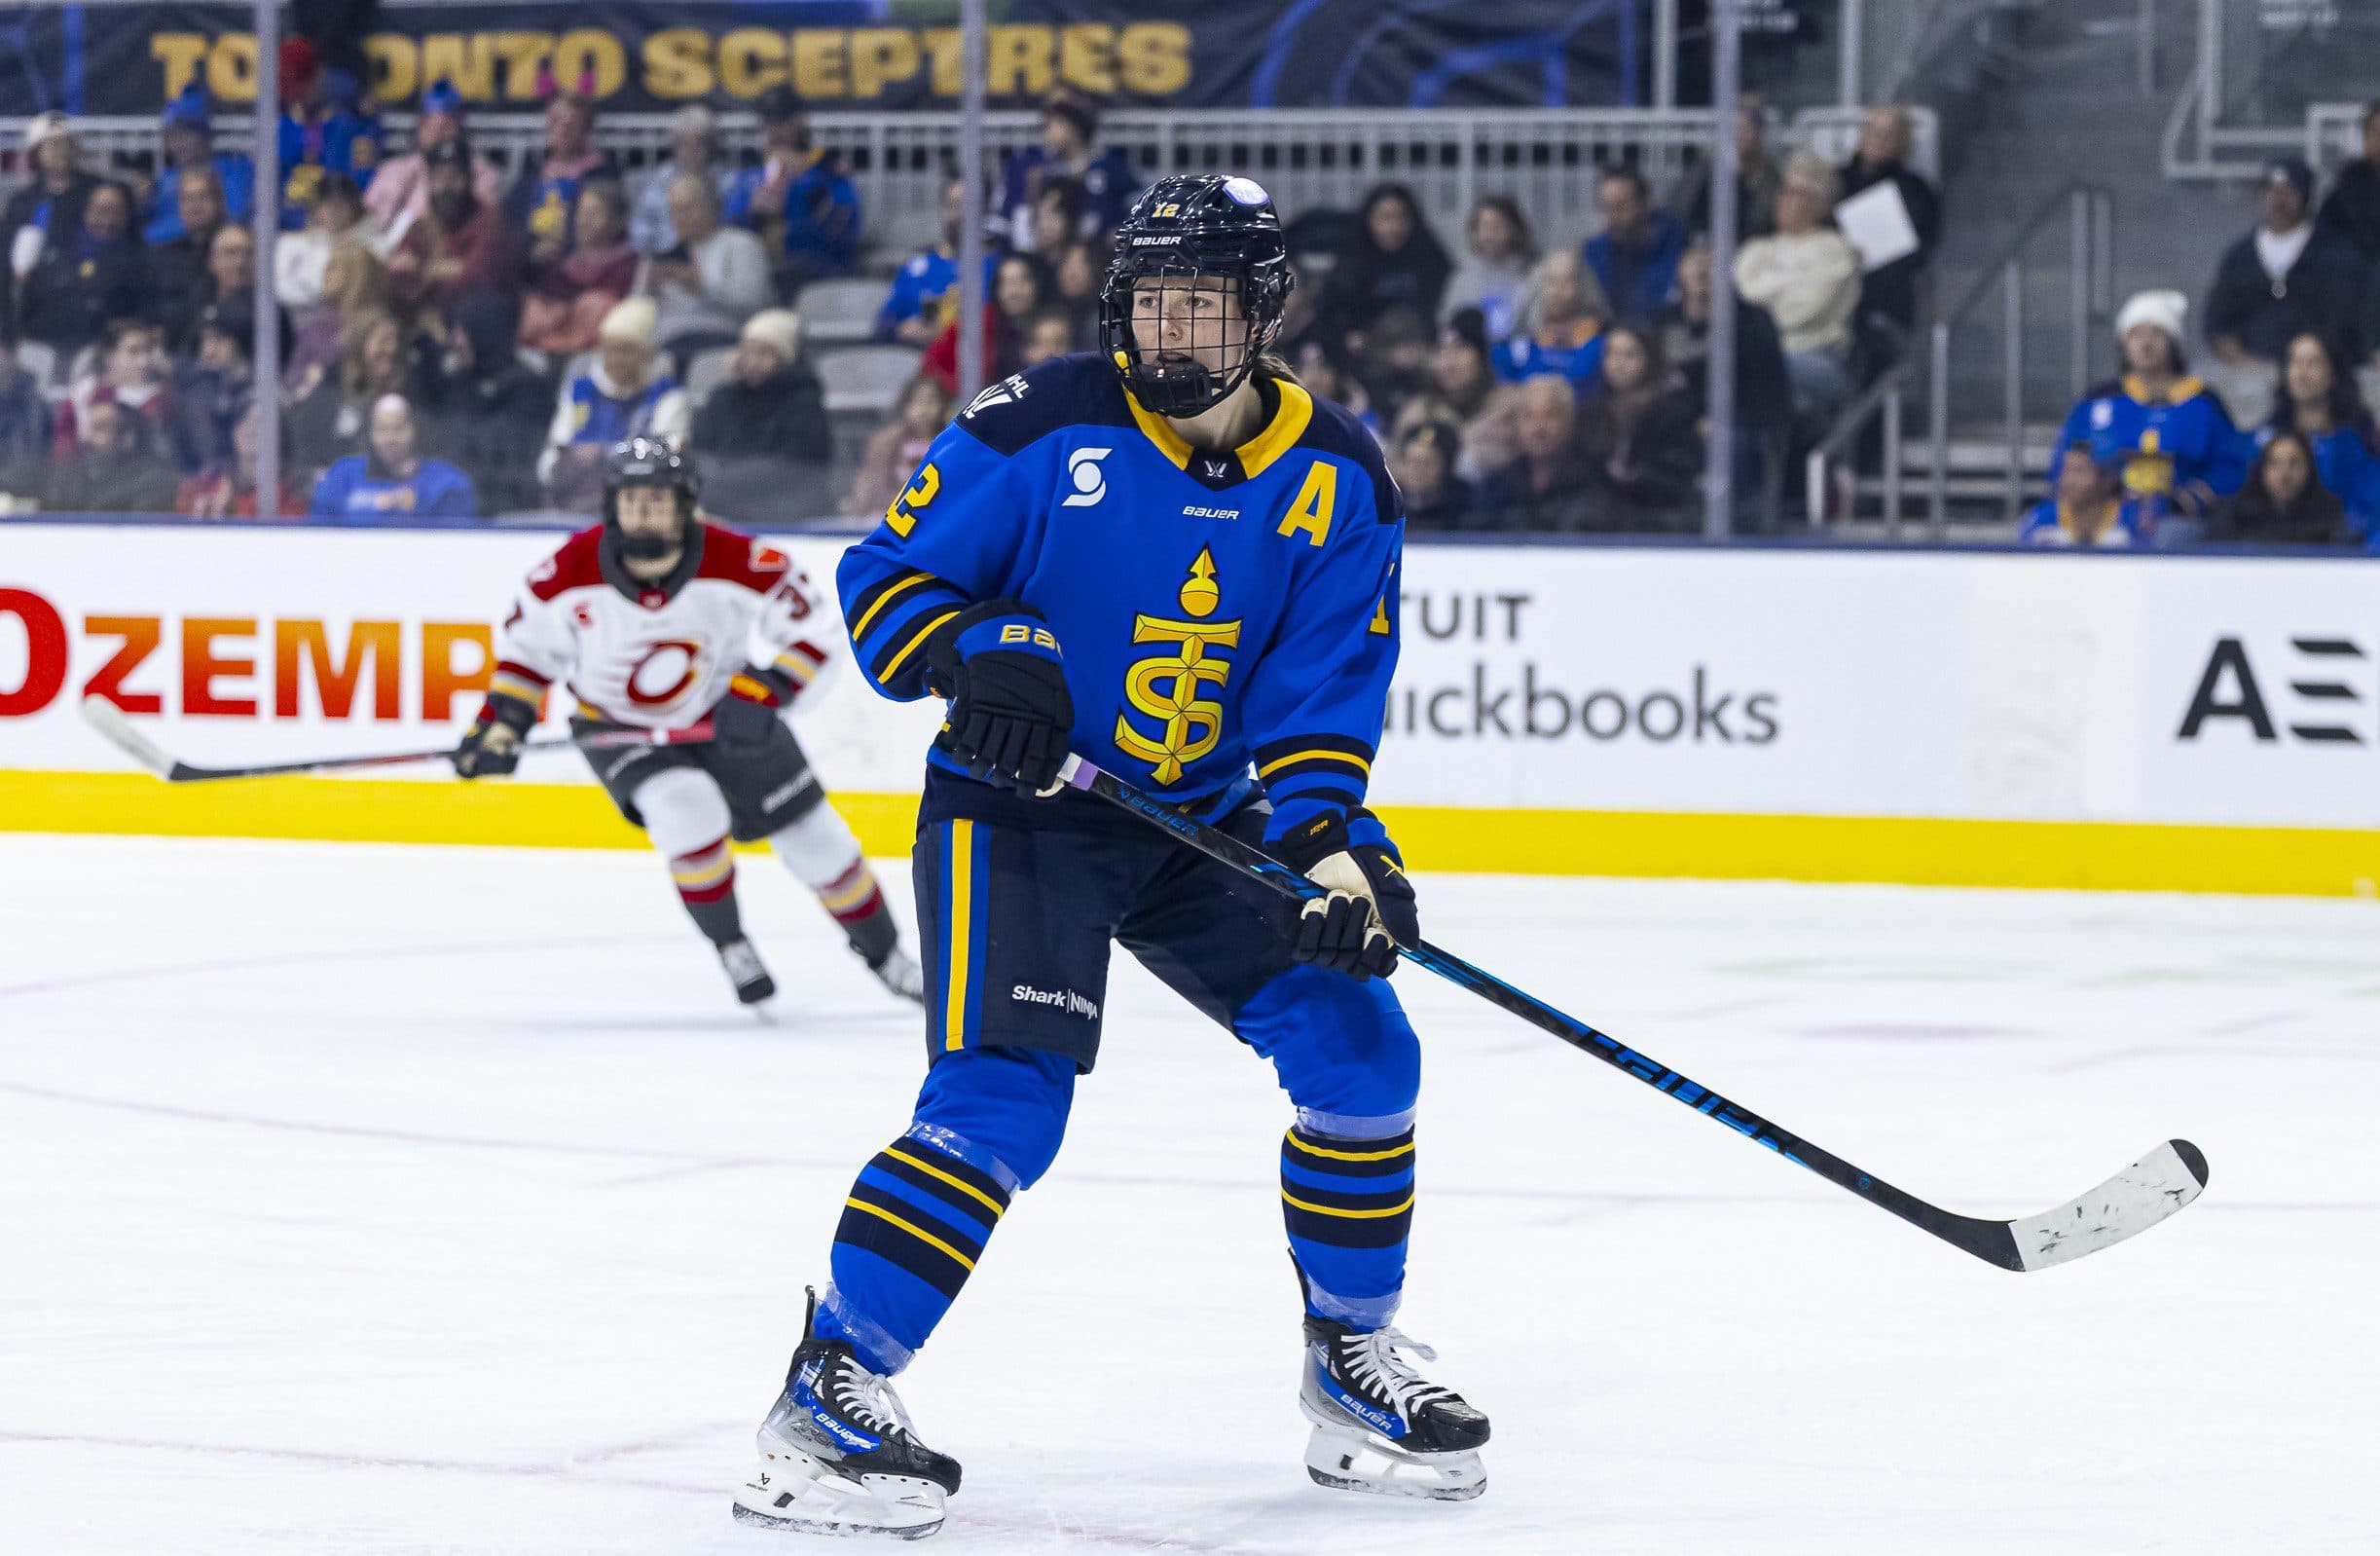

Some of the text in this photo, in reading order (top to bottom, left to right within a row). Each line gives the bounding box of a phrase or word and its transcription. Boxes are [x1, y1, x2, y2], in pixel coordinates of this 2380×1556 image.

[151, 21, 1192, 101] TOONTO SCEPTRES
[1152, 202, 1181, 218] 12
[1277, 461, 1337, 546] A
[0, 583, 548, 722] OZEMP
[1401, 593, 1530, 642] UIT
